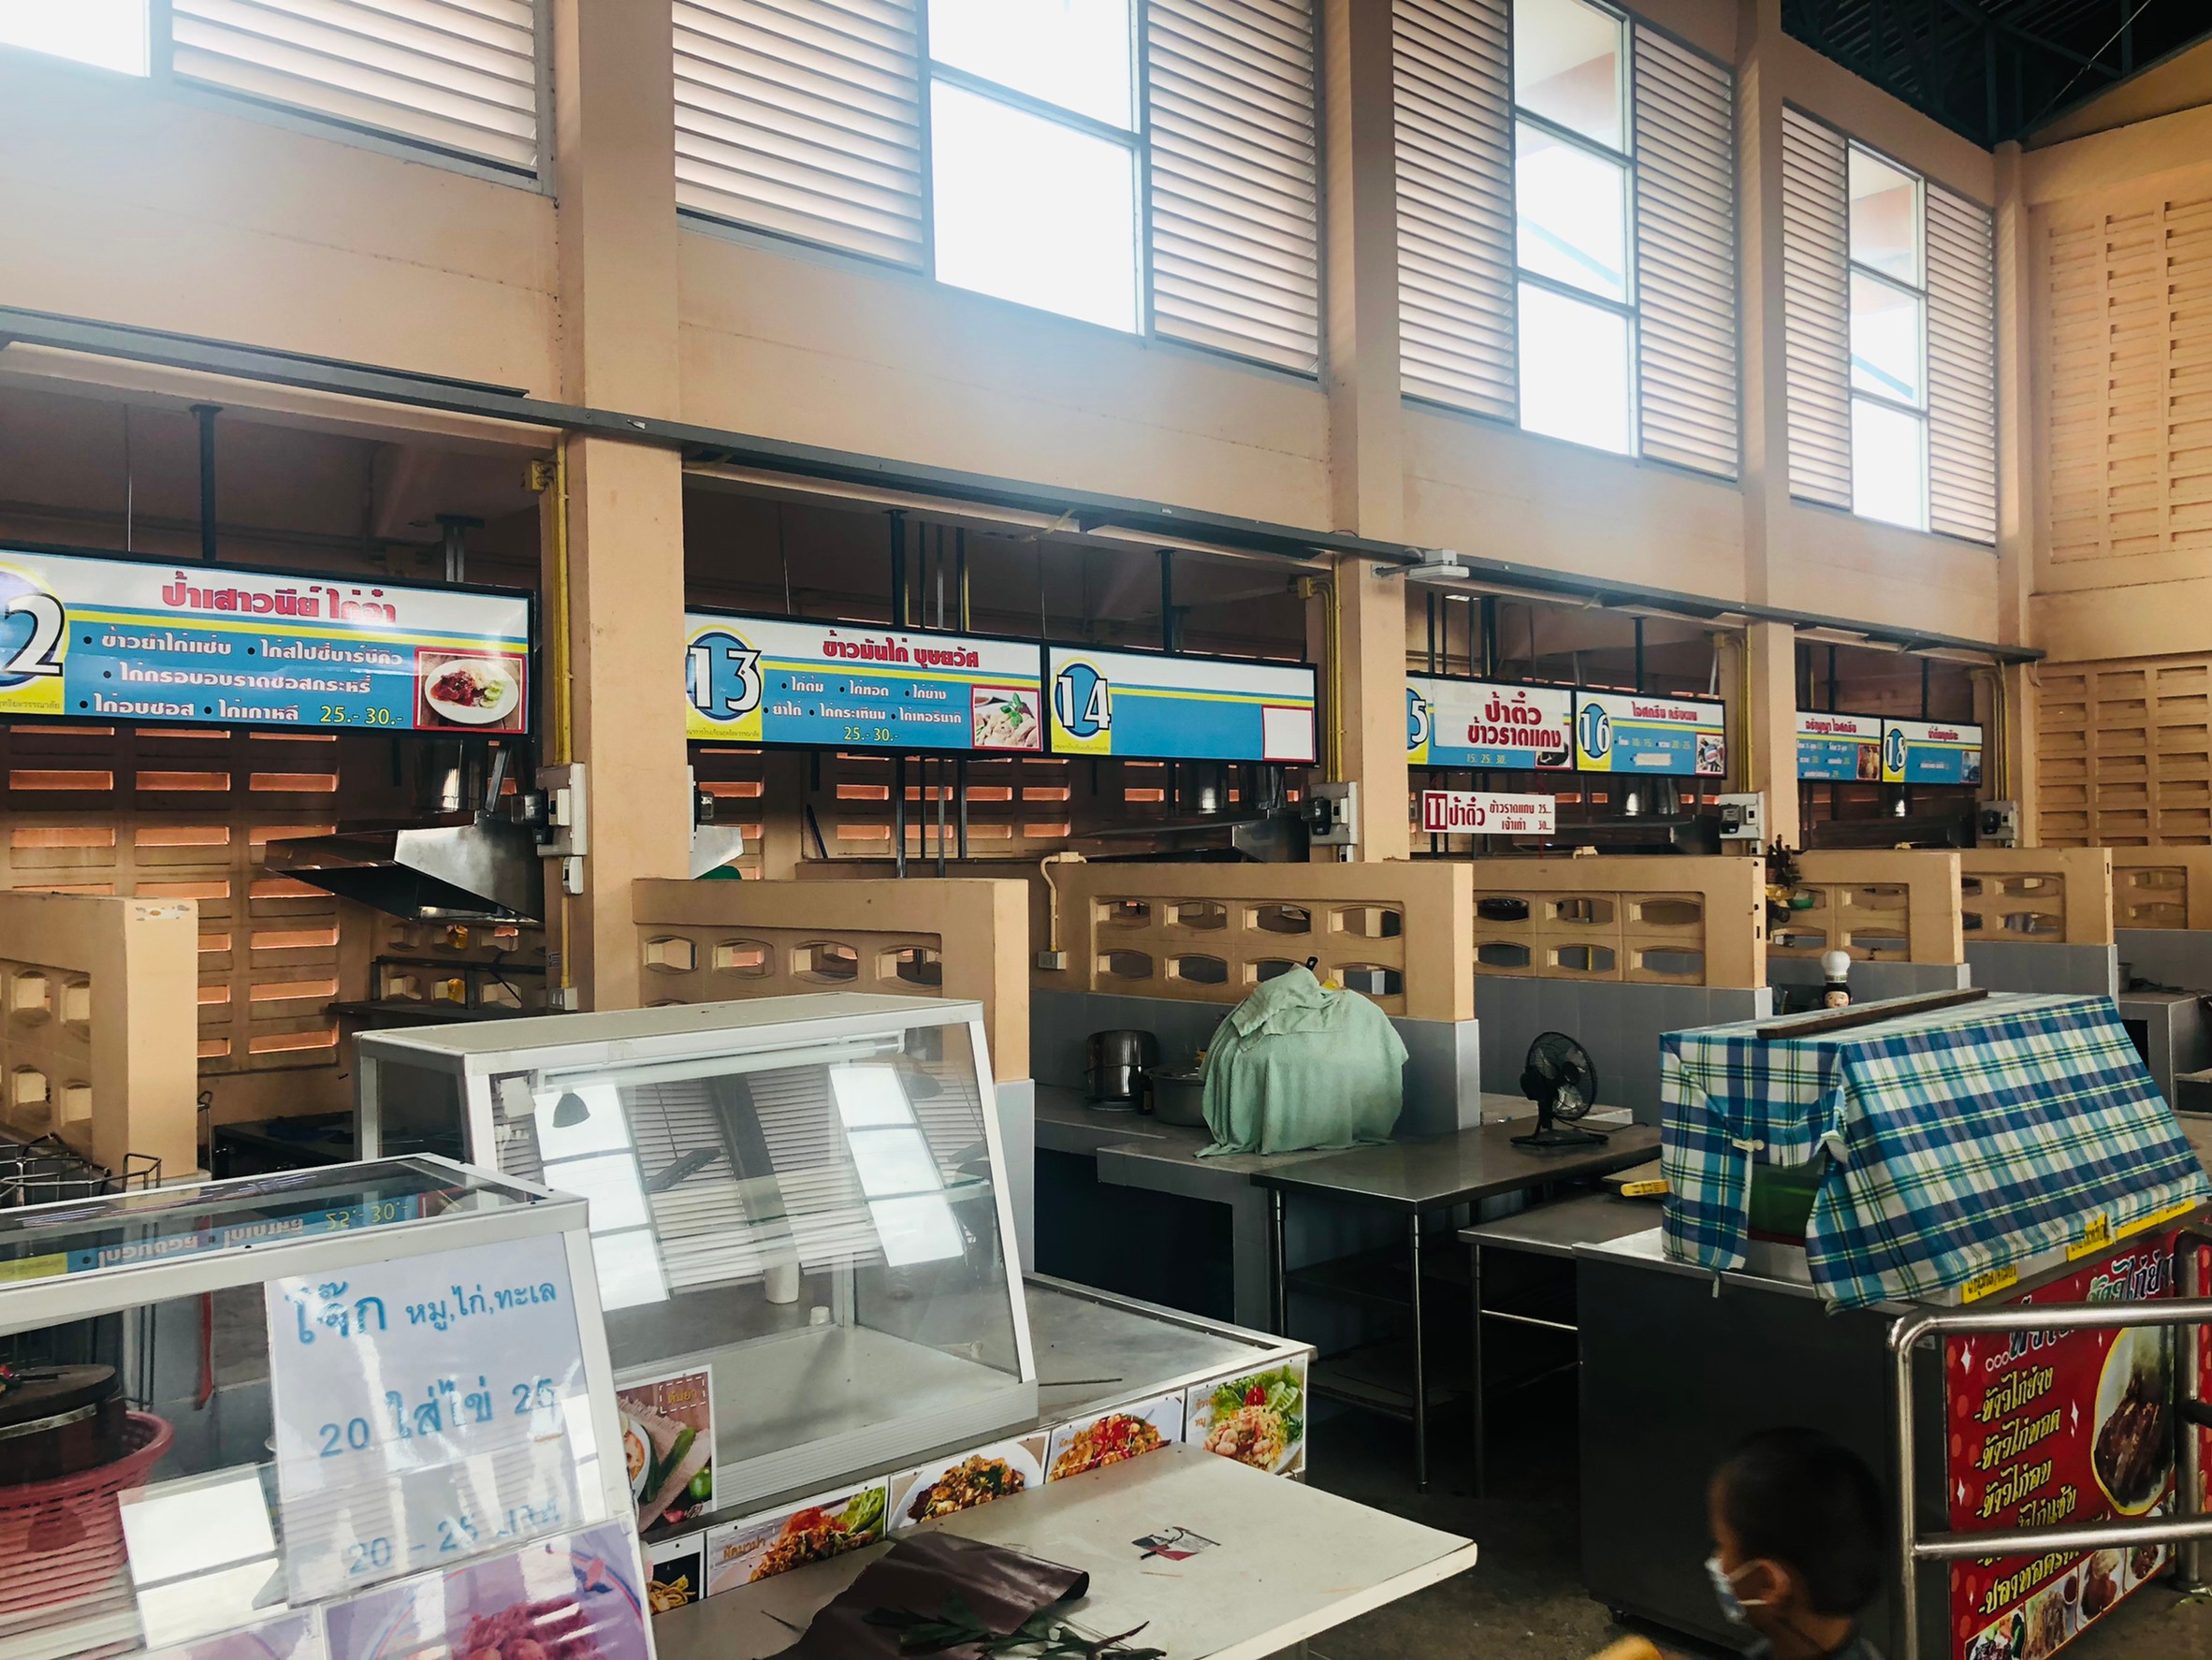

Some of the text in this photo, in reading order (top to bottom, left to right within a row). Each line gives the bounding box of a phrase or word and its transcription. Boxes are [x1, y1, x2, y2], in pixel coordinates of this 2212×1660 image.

[162, 570, 322, 618] ป้าเสาวนีย์
[823, 630, 909, 663] ข้าวมันไก่
[688, 645, 762, 713] 13
[94, 692, 195, 717] ไก่อบซอส
[219, 699, 299, 721] ไก่เกาหลี
[1056, 675, 1112, 730] 14
[1485, 691, 1541, 725] ป้าติ๋ว
[1467, 716, 1561, 748] ข้าวราดแกง
[1580, 711, 1611, 753] 16
[1885, 736, 1906, 767] 18
[319, 1417, 370, 1458] 20
